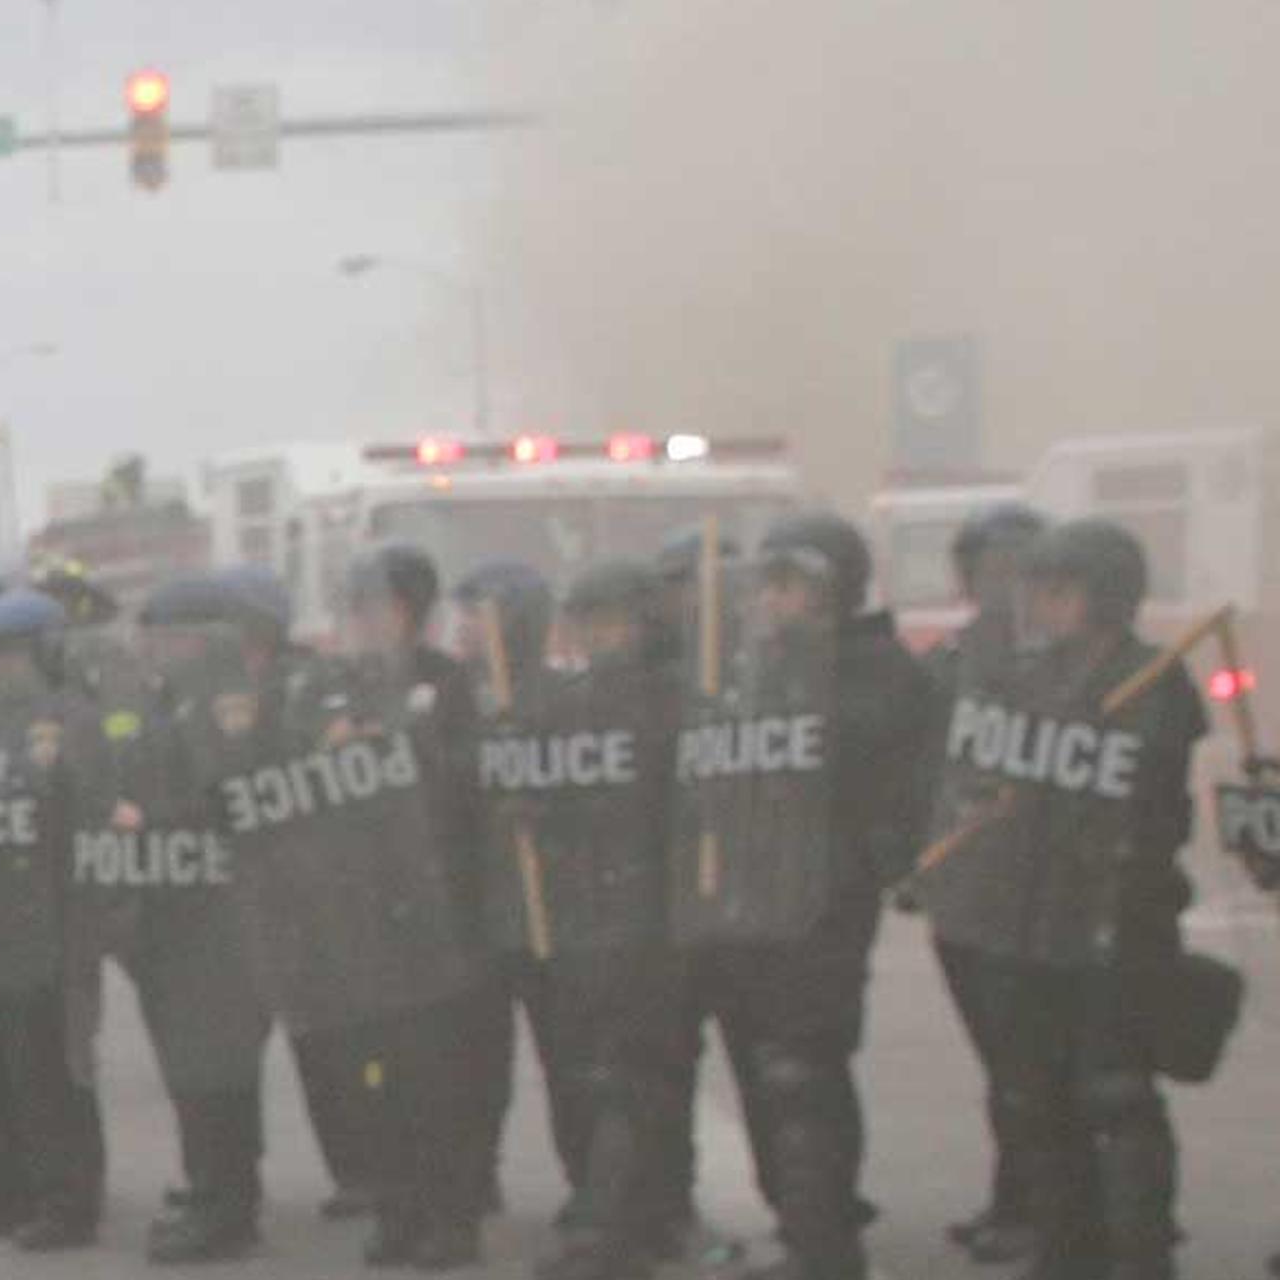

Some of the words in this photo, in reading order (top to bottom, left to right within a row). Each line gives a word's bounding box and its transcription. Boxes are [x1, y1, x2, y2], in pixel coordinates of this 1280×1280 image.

[480, 730, 634, 788] POLICE
[679, 716, 823, 778] POLICE
[948, 697, 1140, 797] POLICE
[223, 732, 416, 830] POLICE
[74, 828, 233, 885] POLICE
